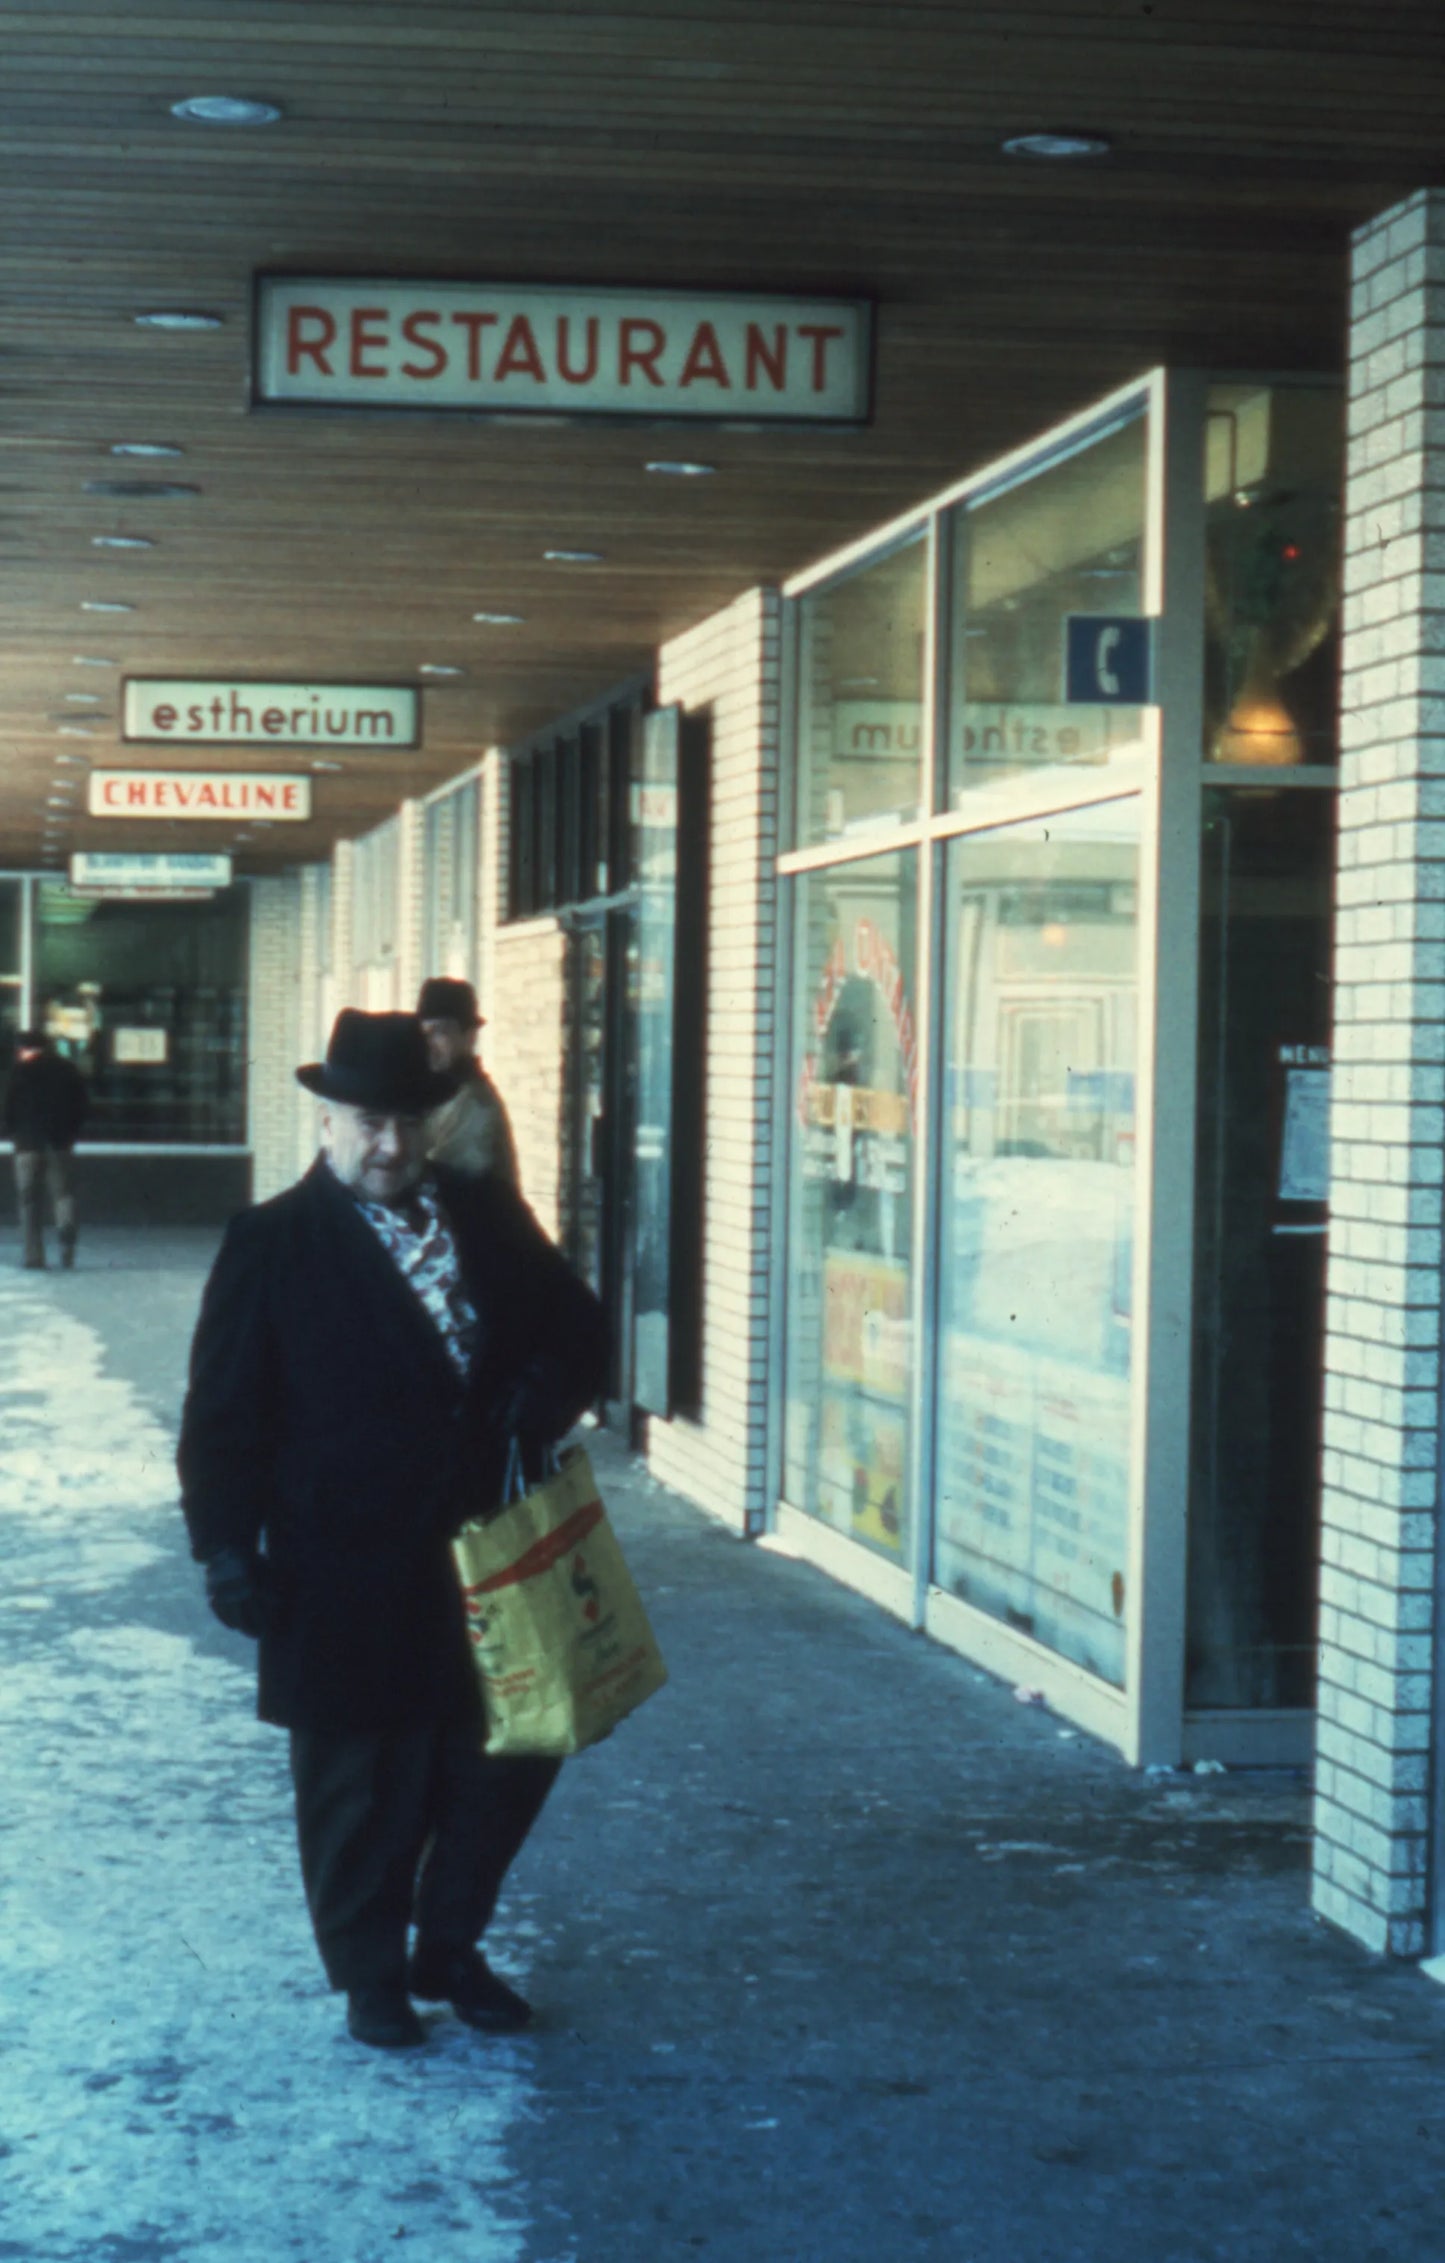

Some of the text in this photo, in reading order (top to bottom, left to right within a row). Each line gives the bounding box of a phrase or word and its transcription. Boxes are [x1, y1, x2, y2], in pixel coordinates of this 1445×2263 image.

[286, 305, 844, 392] RESTAURANT
[152, 690, 394, 737] estherium
[102, 780, 298, 810] CHEVALINE
